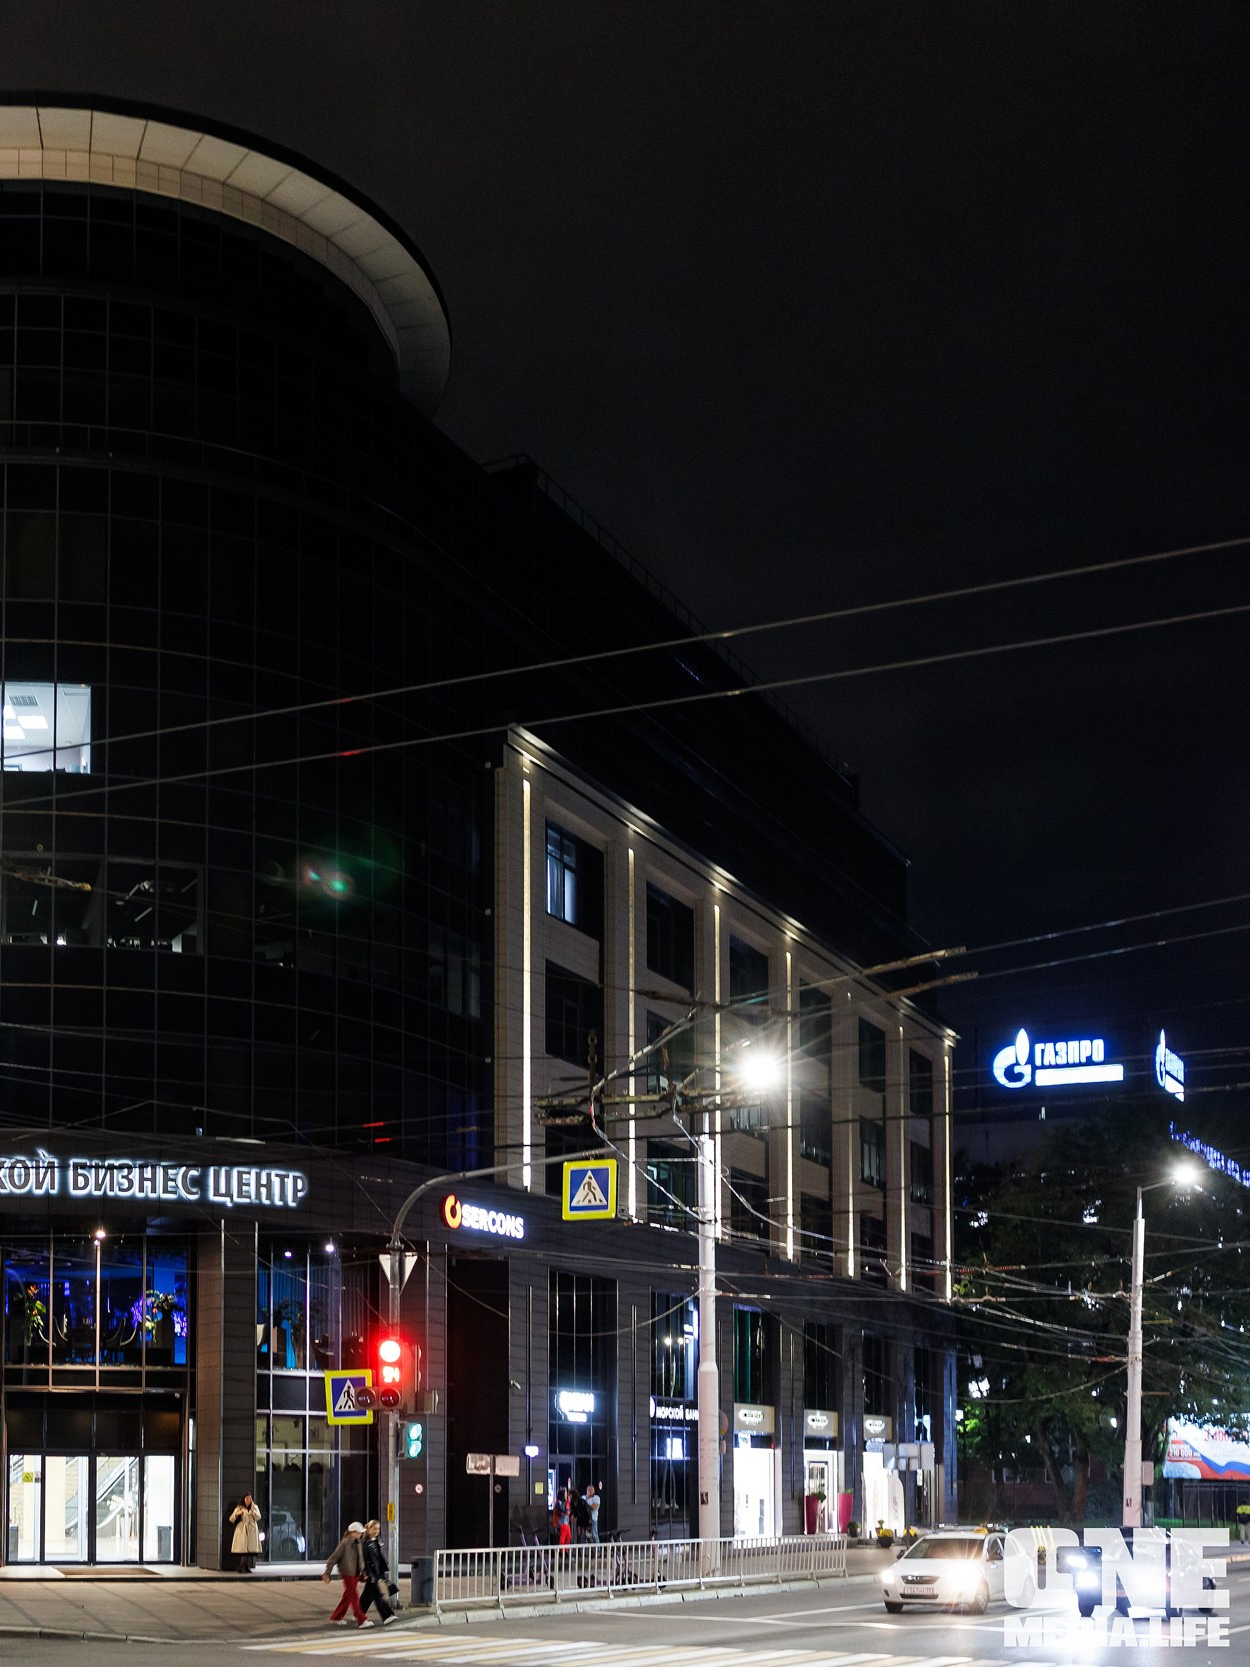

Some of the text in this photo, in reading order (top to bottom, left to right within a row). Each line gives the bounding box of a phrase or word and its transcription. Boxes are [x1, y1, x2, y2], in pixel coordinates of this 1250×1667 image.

[69, 1158, 201, 1200] БИЗНЕС
[209, 1165, 309, 1208] ЦЕНТР
[461, 1203, 525, 1240] SERCONS
